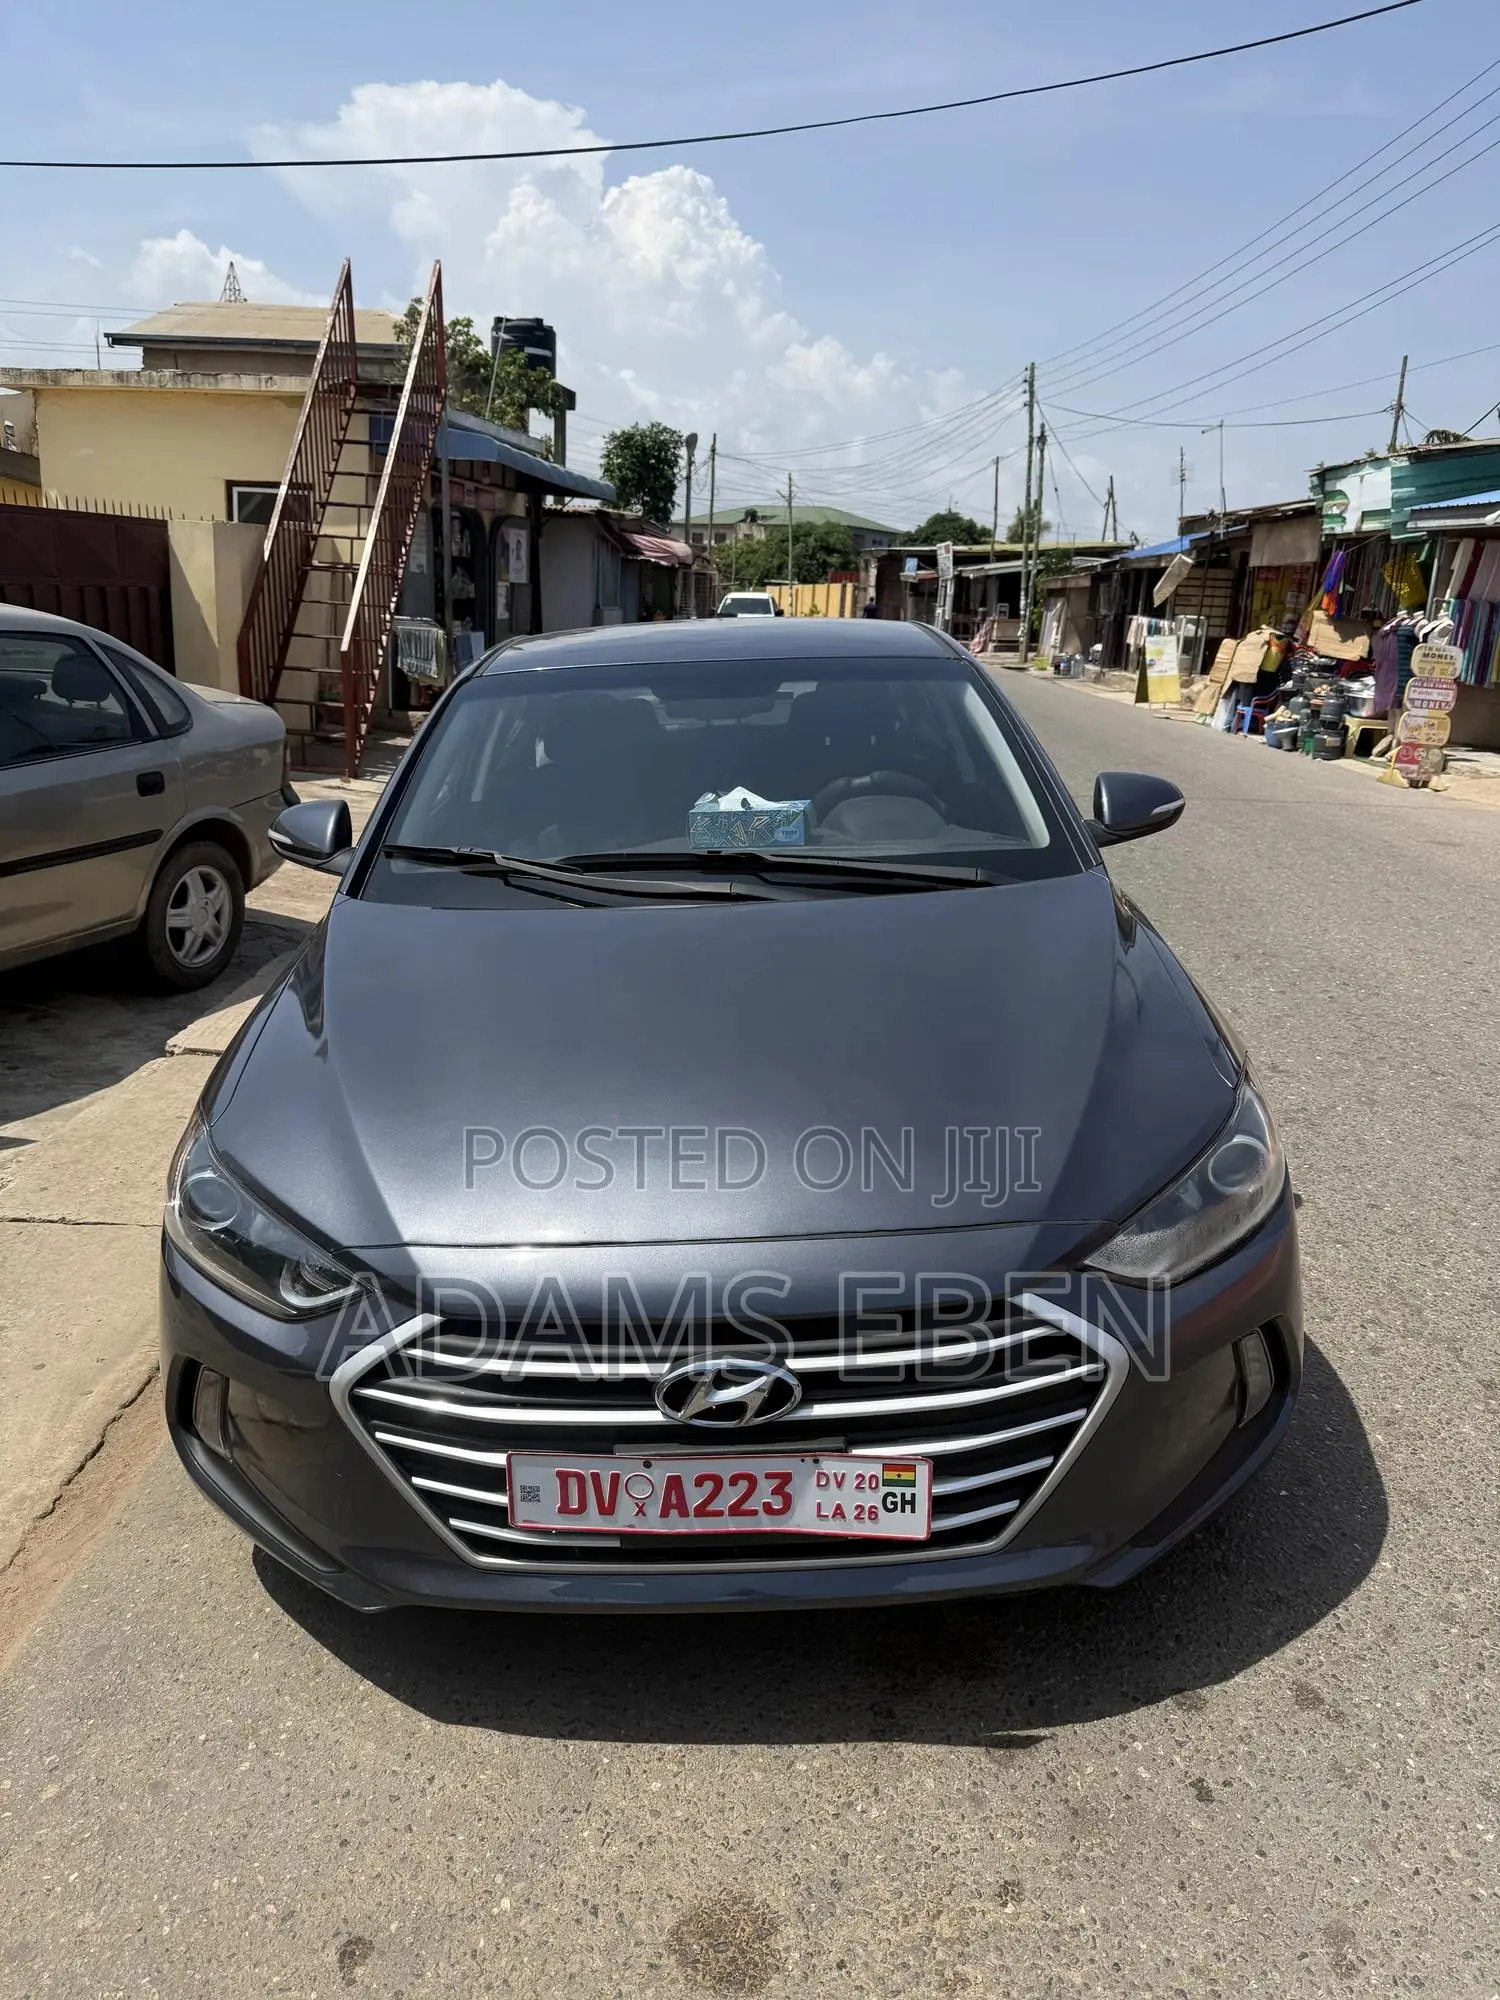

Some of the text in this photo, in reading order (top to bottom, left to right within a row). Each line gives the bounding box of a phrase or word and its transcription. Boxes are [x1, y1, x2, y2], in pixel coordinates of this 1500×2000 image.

[816, 1470, 880, 1491] DV 20
[555, 1468, 794, 1518] DV A223
[881, 1491, 917, 1514] GH
[816, 1500, 880, 1521] LA 26
